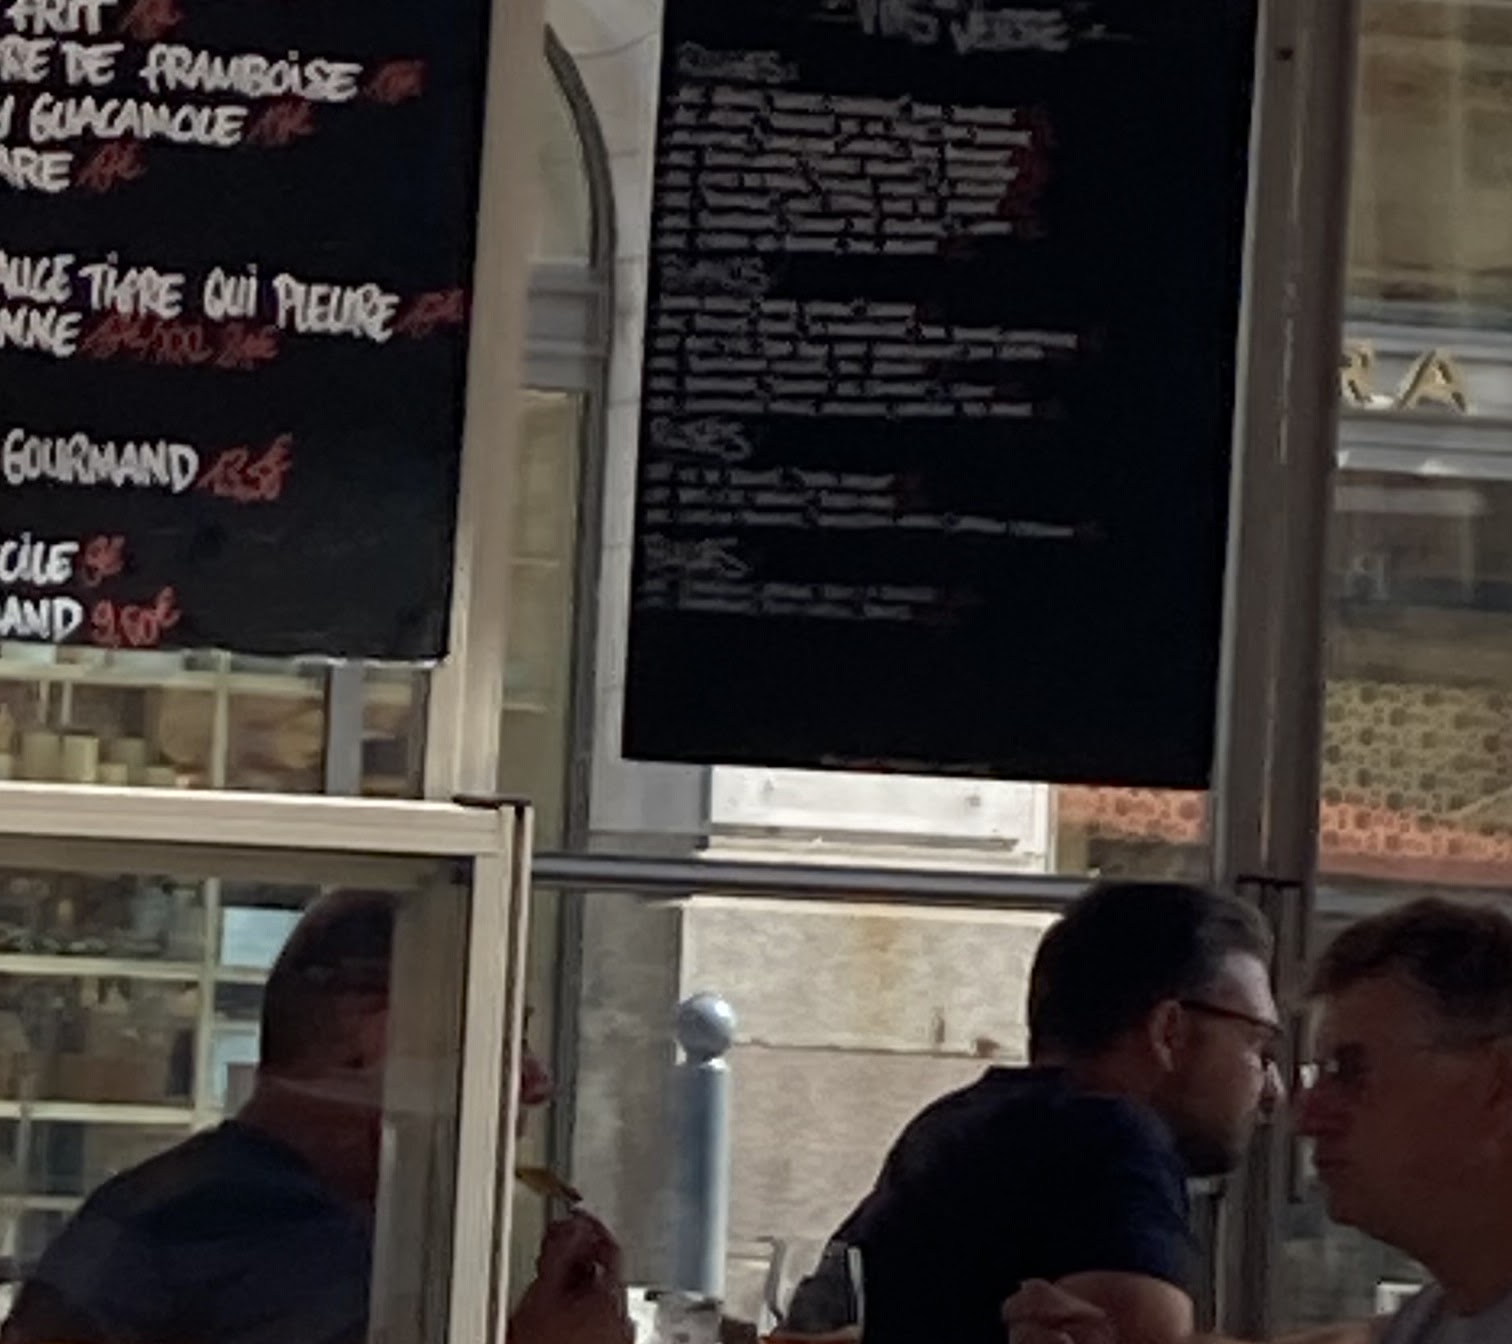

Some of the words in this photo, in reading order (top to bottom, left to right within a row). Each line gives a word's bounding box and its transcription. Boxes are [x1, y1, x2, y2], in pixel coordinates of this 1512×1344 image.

[60, 41, 124, 84] DE
[140, 43, 363, 103] FRAMBOISE
[28, 94, 249, 146] GUACAMOLE
[204, 264, 258, 318] QUI
[273, 274, 399, 343] PLEURE
[3, 428, 199, 493] GOURMAND
